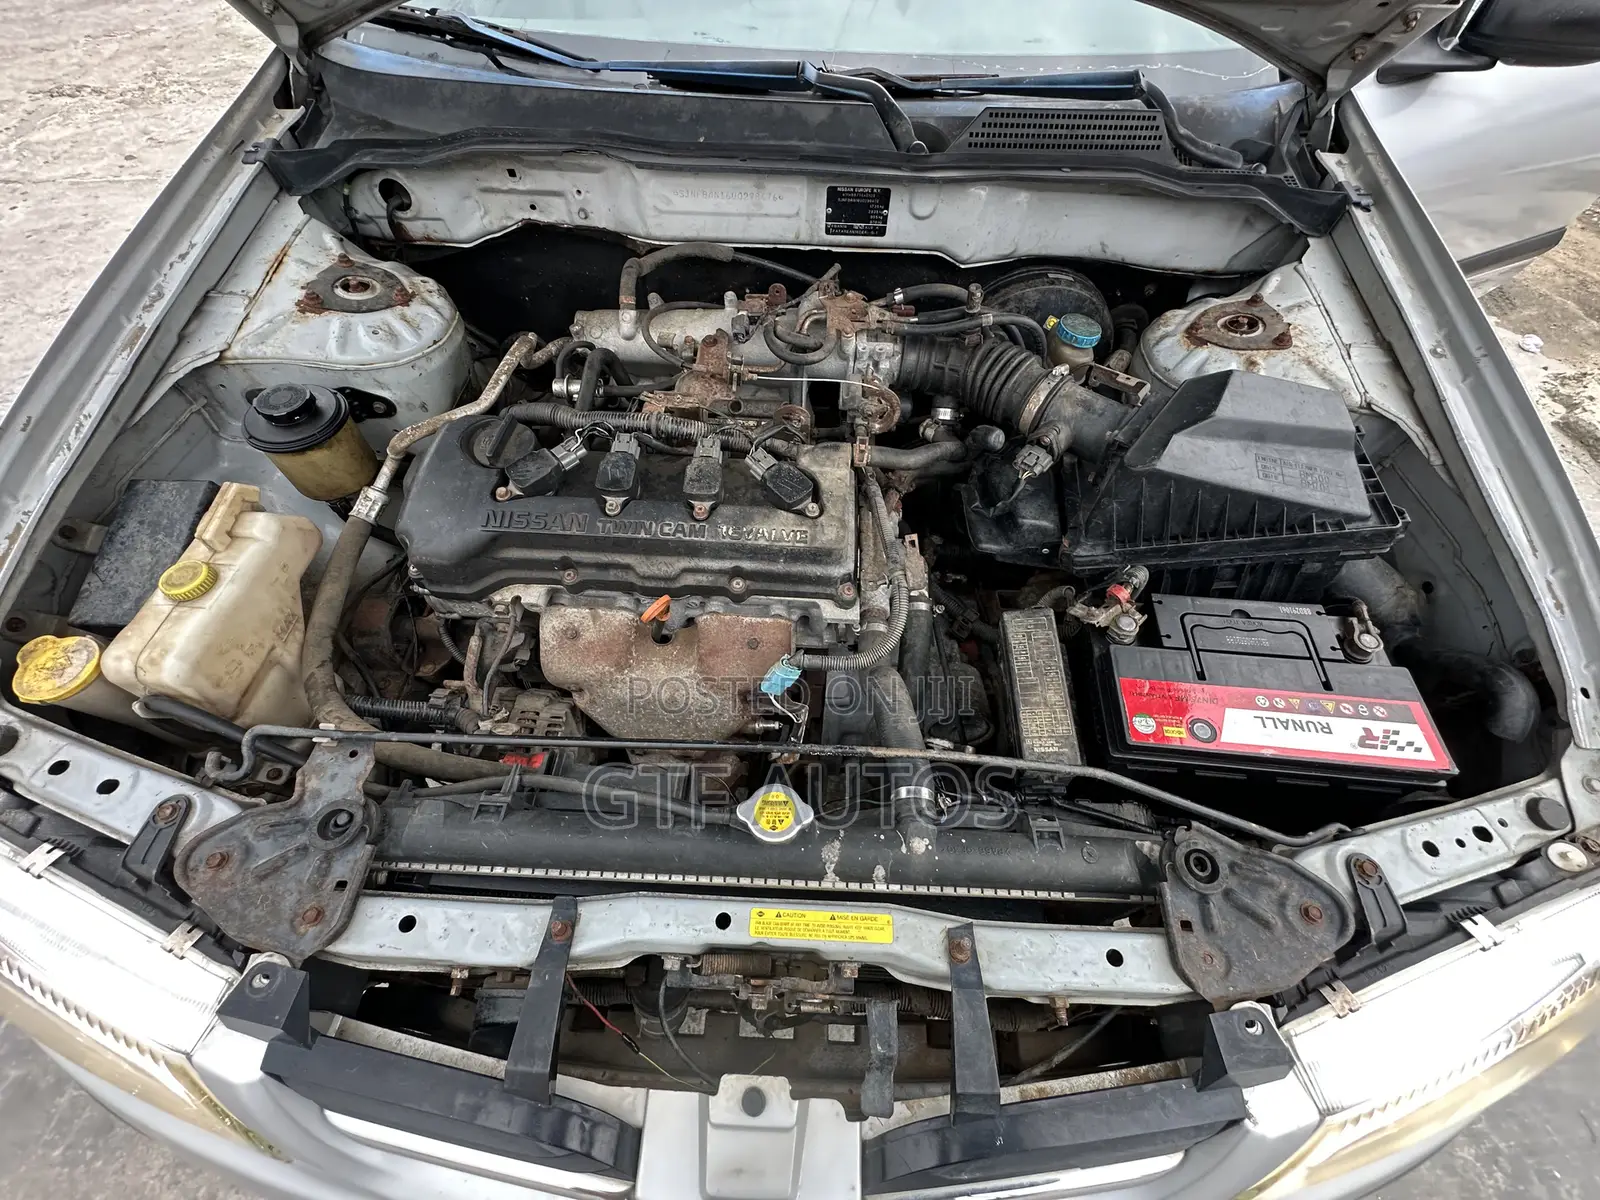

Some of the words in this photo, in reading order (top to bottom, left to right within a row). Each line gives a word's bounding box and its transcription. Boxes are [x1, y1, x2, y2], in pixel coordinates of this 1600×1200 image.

[481, 508, 588, 533] NISSAN
[599, 518, 654, 537] TWIN
[658, 522, 707, 541] CAM
[1253, 715, 1333, 735] RUNALL
